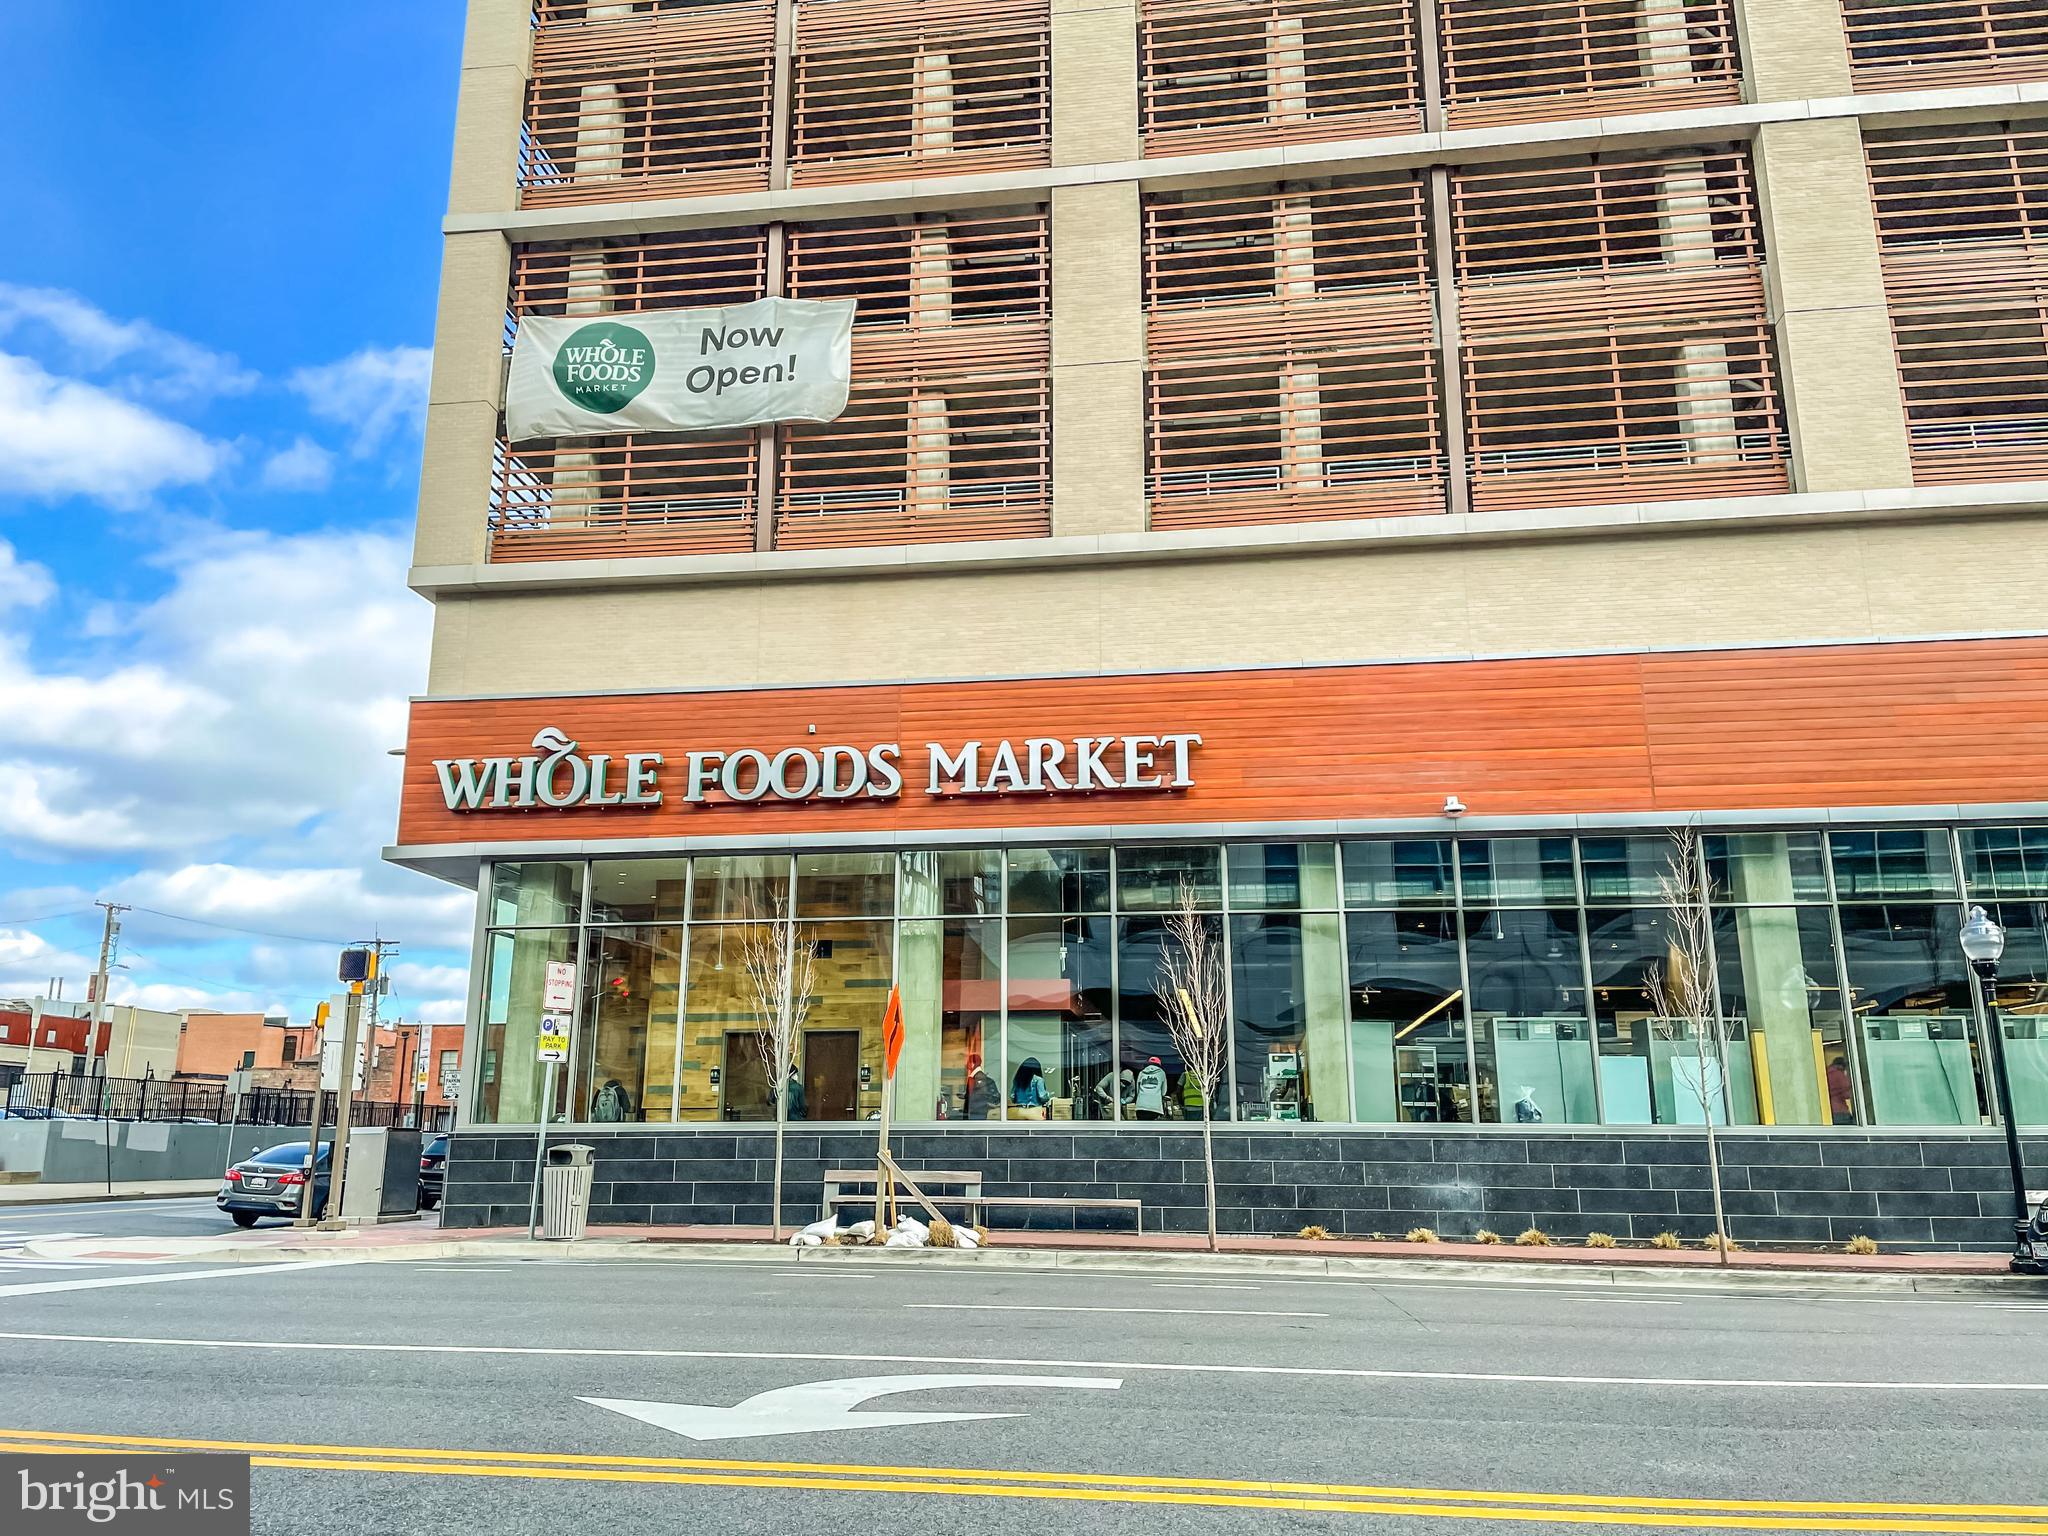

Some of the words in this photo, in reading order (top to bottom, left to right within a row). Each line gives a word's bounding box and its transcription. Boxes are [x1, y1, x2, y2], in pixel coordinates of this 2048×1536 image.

[700, 325, 784, 356] Now
[565, 339, 646, 367] WHOLE
[566, 363, 642, 383] FOODS
[685, 354, 798, 396] Open!
[575, 383, 627, 394] MARKET
[431, 726, 664, 811] WHOLE
[682, 747, 903, 805] FOODS
[924, 733, 1204, 794] MARKET
[548, 978, 573, 988] STOPPING
[557, 967, 567, 976] NO
